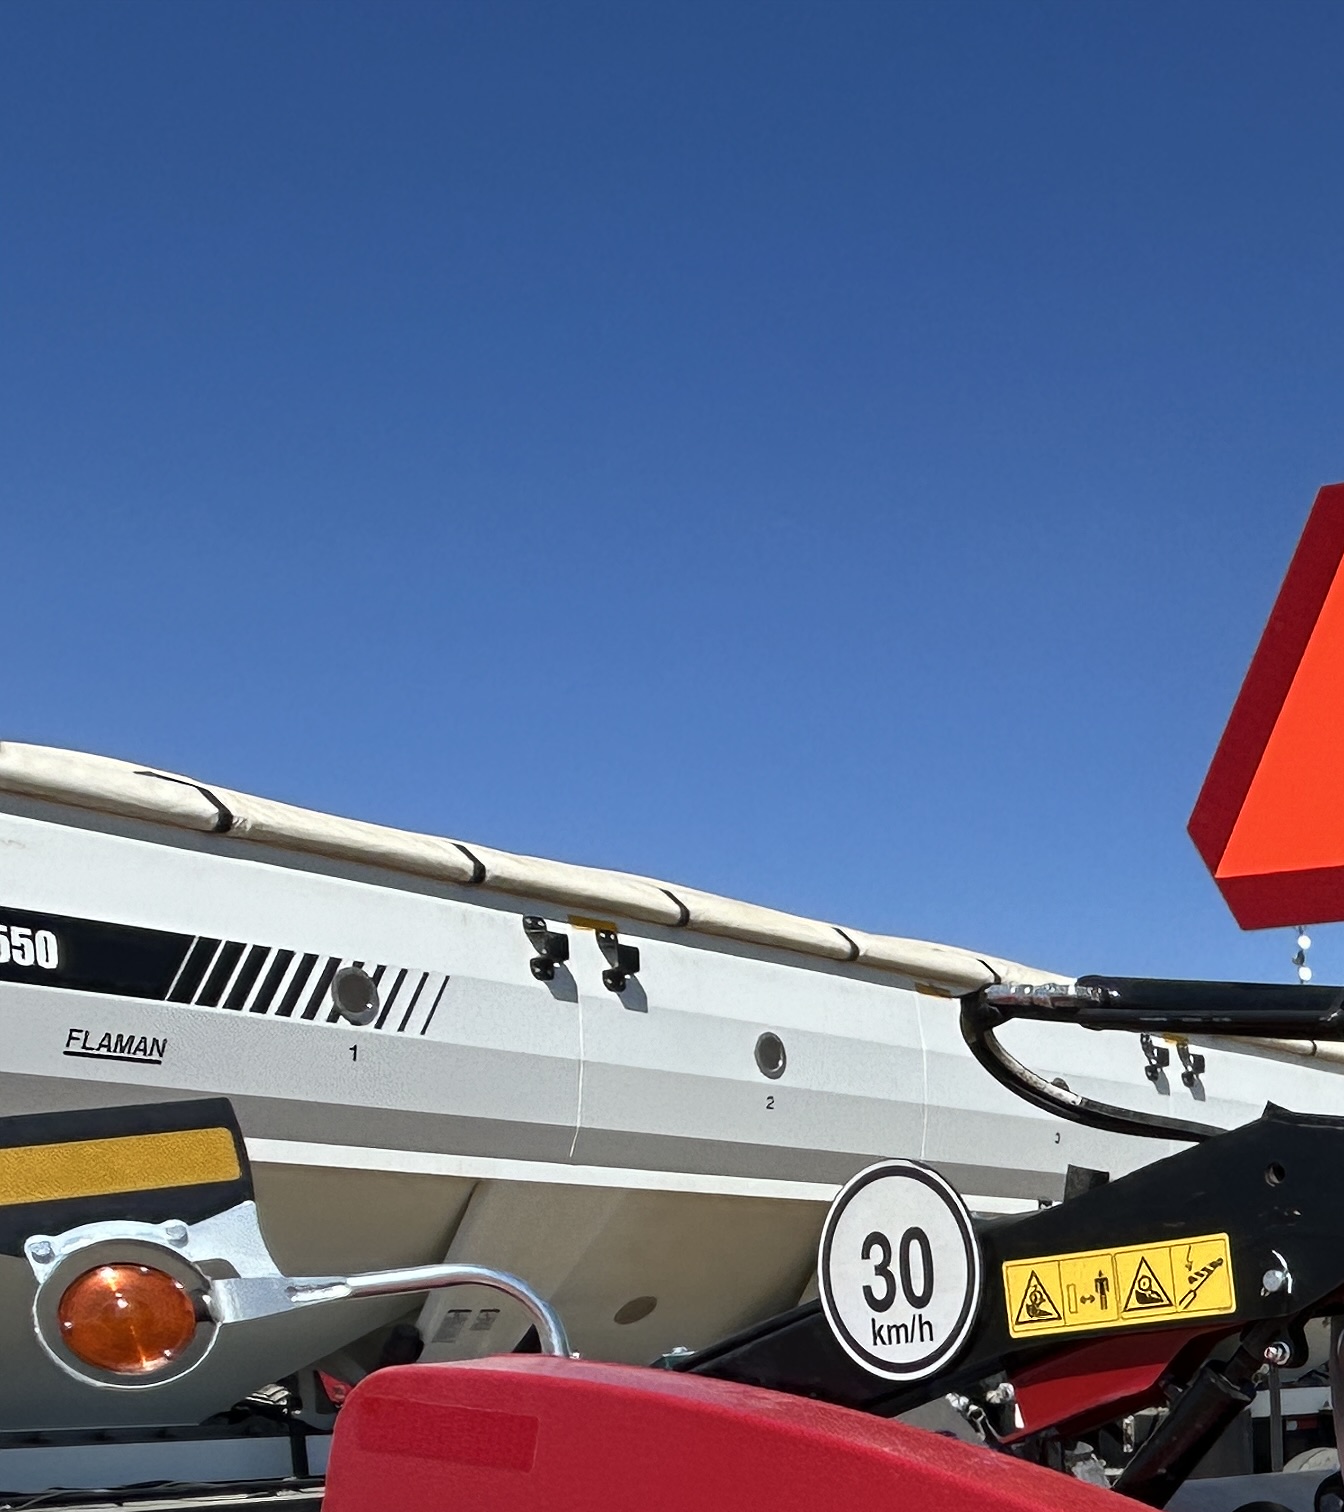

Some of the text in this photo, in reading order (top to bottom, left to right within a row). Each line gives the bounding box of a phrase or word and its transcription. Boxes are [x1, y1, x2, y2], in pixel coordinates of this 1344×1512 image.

[65, 1028, 168, 1058] FLAMAN
[349, 1044, 358, 1062] 1
[766, 1095, 775, 1110] 2
[861, 1226, 935, 1313] 30
[871, 1313, 934, 1346] km/h
